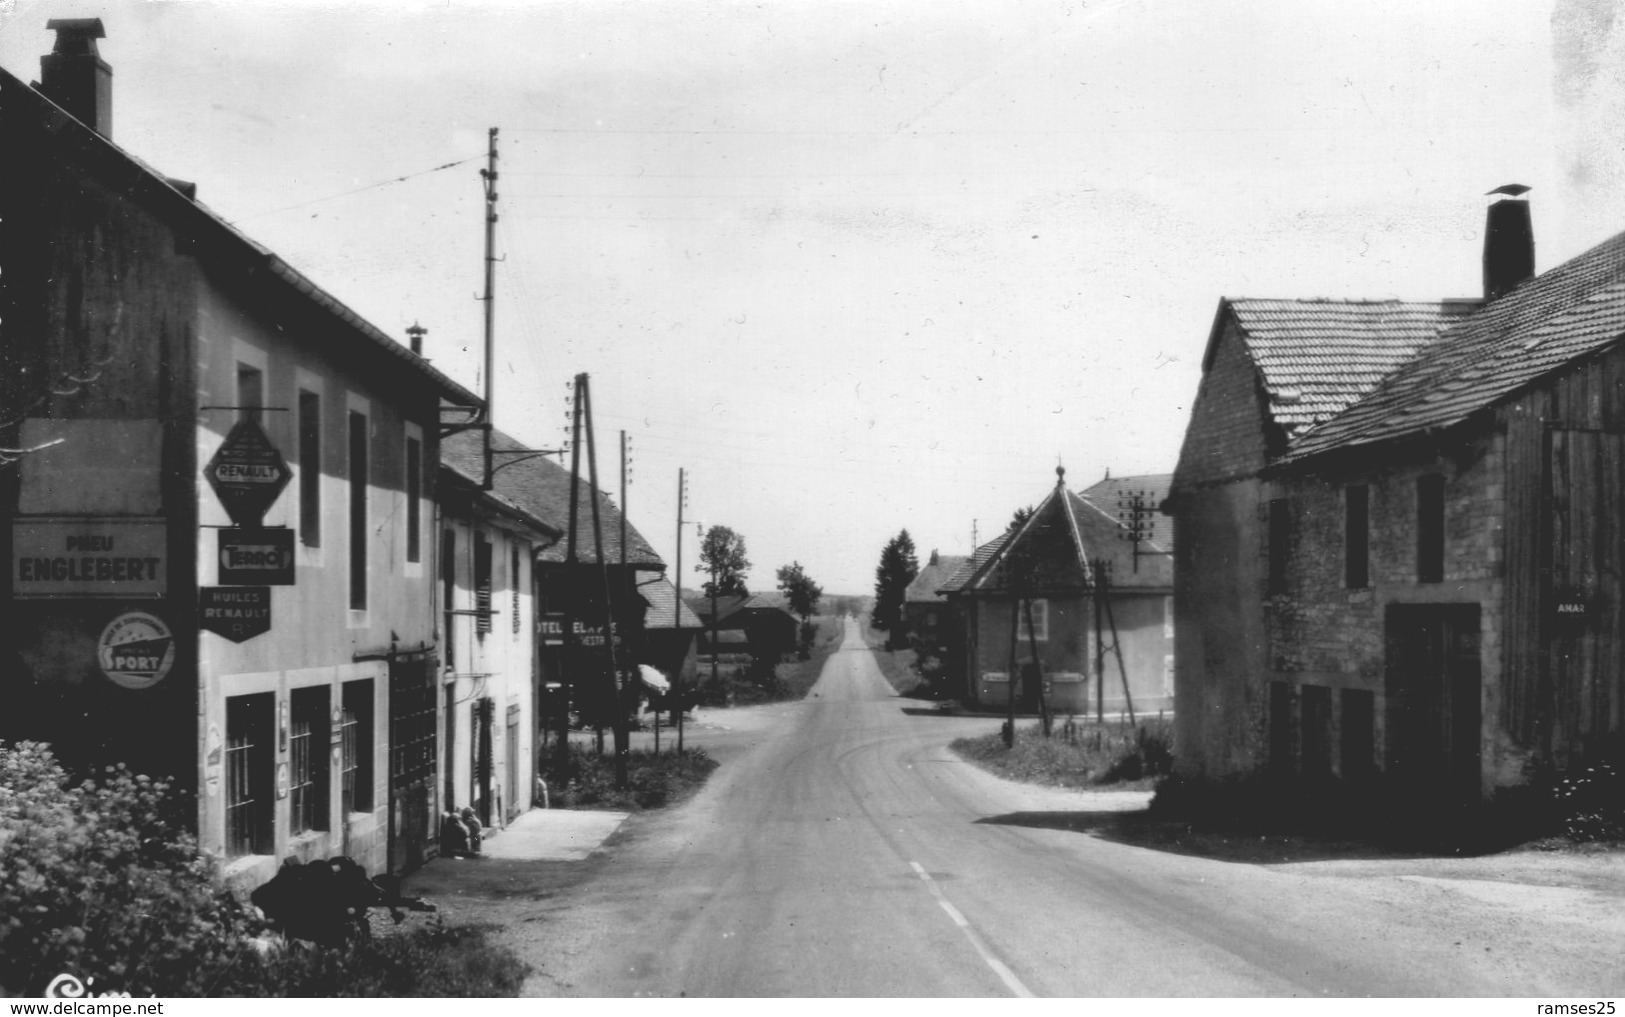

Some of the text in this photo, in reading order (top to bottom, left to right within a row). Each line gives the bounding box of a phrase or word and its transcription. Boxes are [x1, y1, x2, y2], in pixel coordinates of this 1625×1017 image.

[220, 466, 275, 477] RENAULT
[66, 535, 113, 551] PNEU
[225, 546, 288, 568] TERROT
[19, 557, 160, 581] ENGLEBERT
[212, 592, 260, 602] HUILES
[204, 607, 268, 618] RENAULT
[104, 647, 160, 670] SPORT
